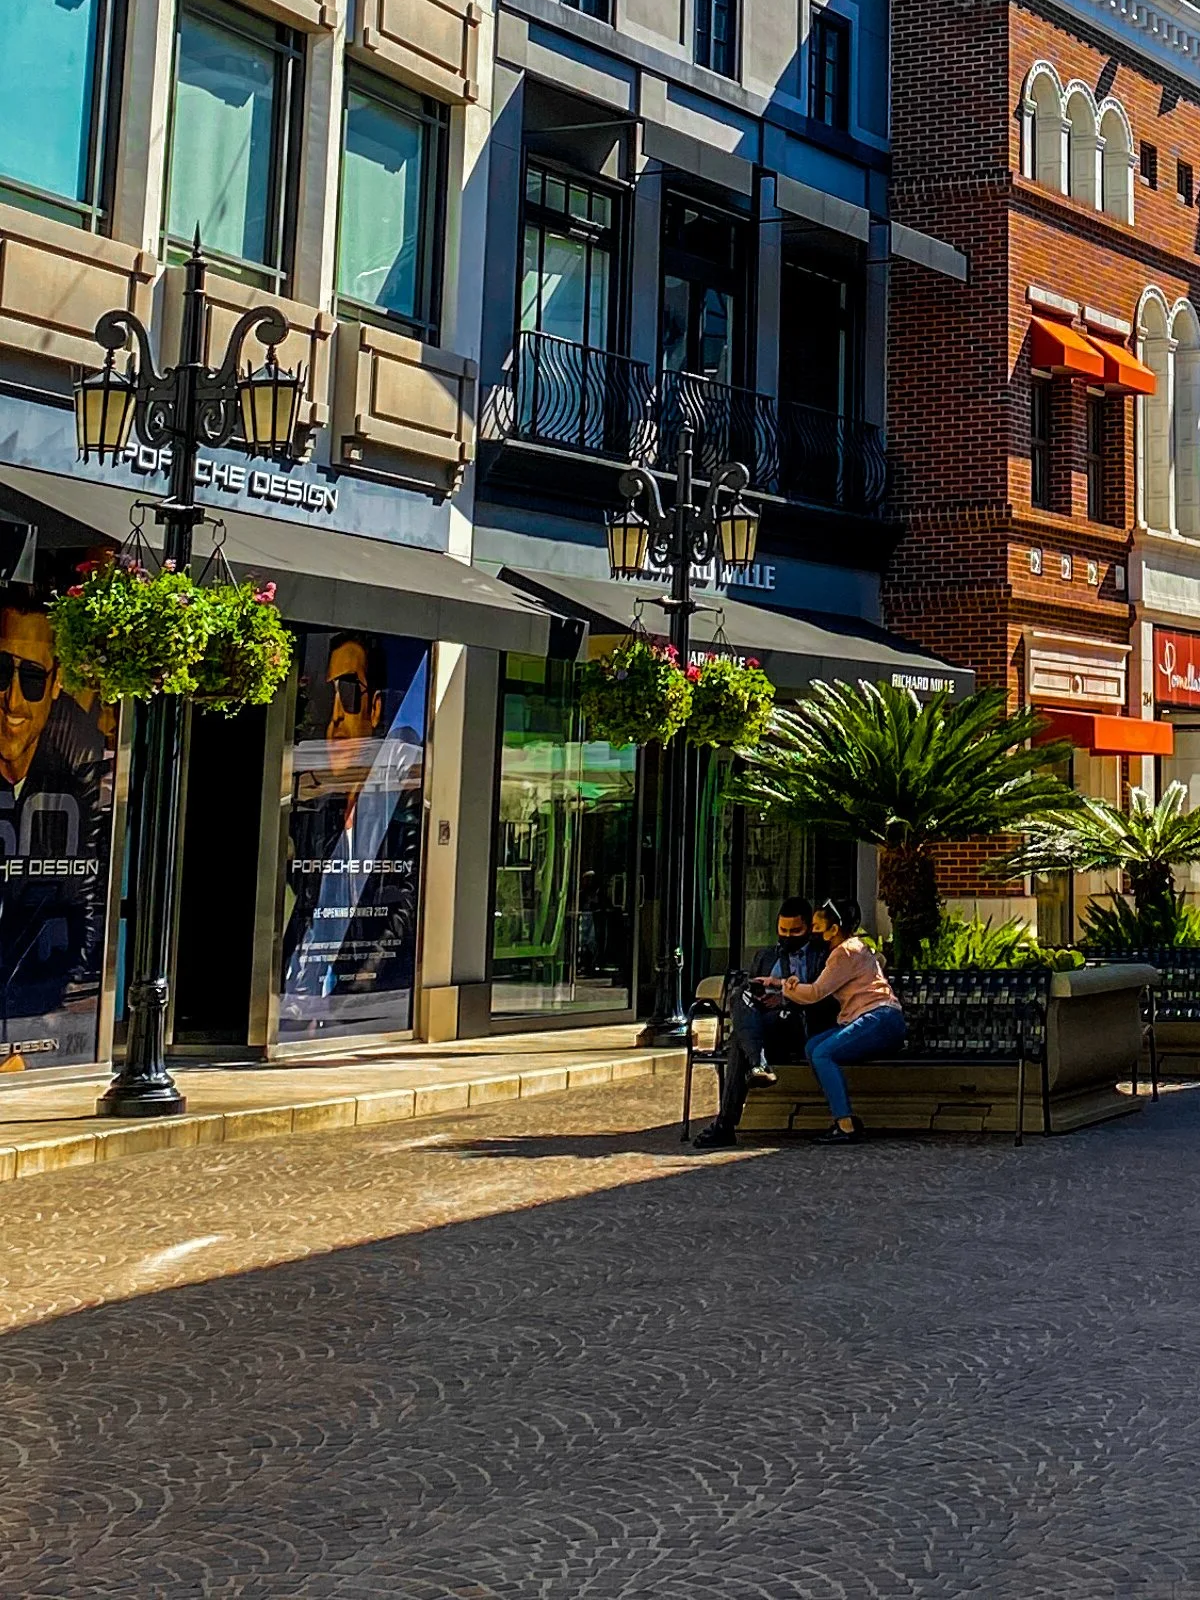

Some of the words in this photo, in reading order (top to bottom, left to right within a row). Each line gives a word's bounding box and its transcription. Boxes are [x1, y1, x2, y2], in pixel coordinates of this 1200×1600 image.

[118, 441, 245, 489] PORCHE
[253, 470, 339, 511] DESIGN
[892, 673, 929, 691] RICHARD
[29, 859, 99, 875] DESIGN
[291, 860, 360, 873] PORSCHE
[363, 860, 413, 873] DESIGN
